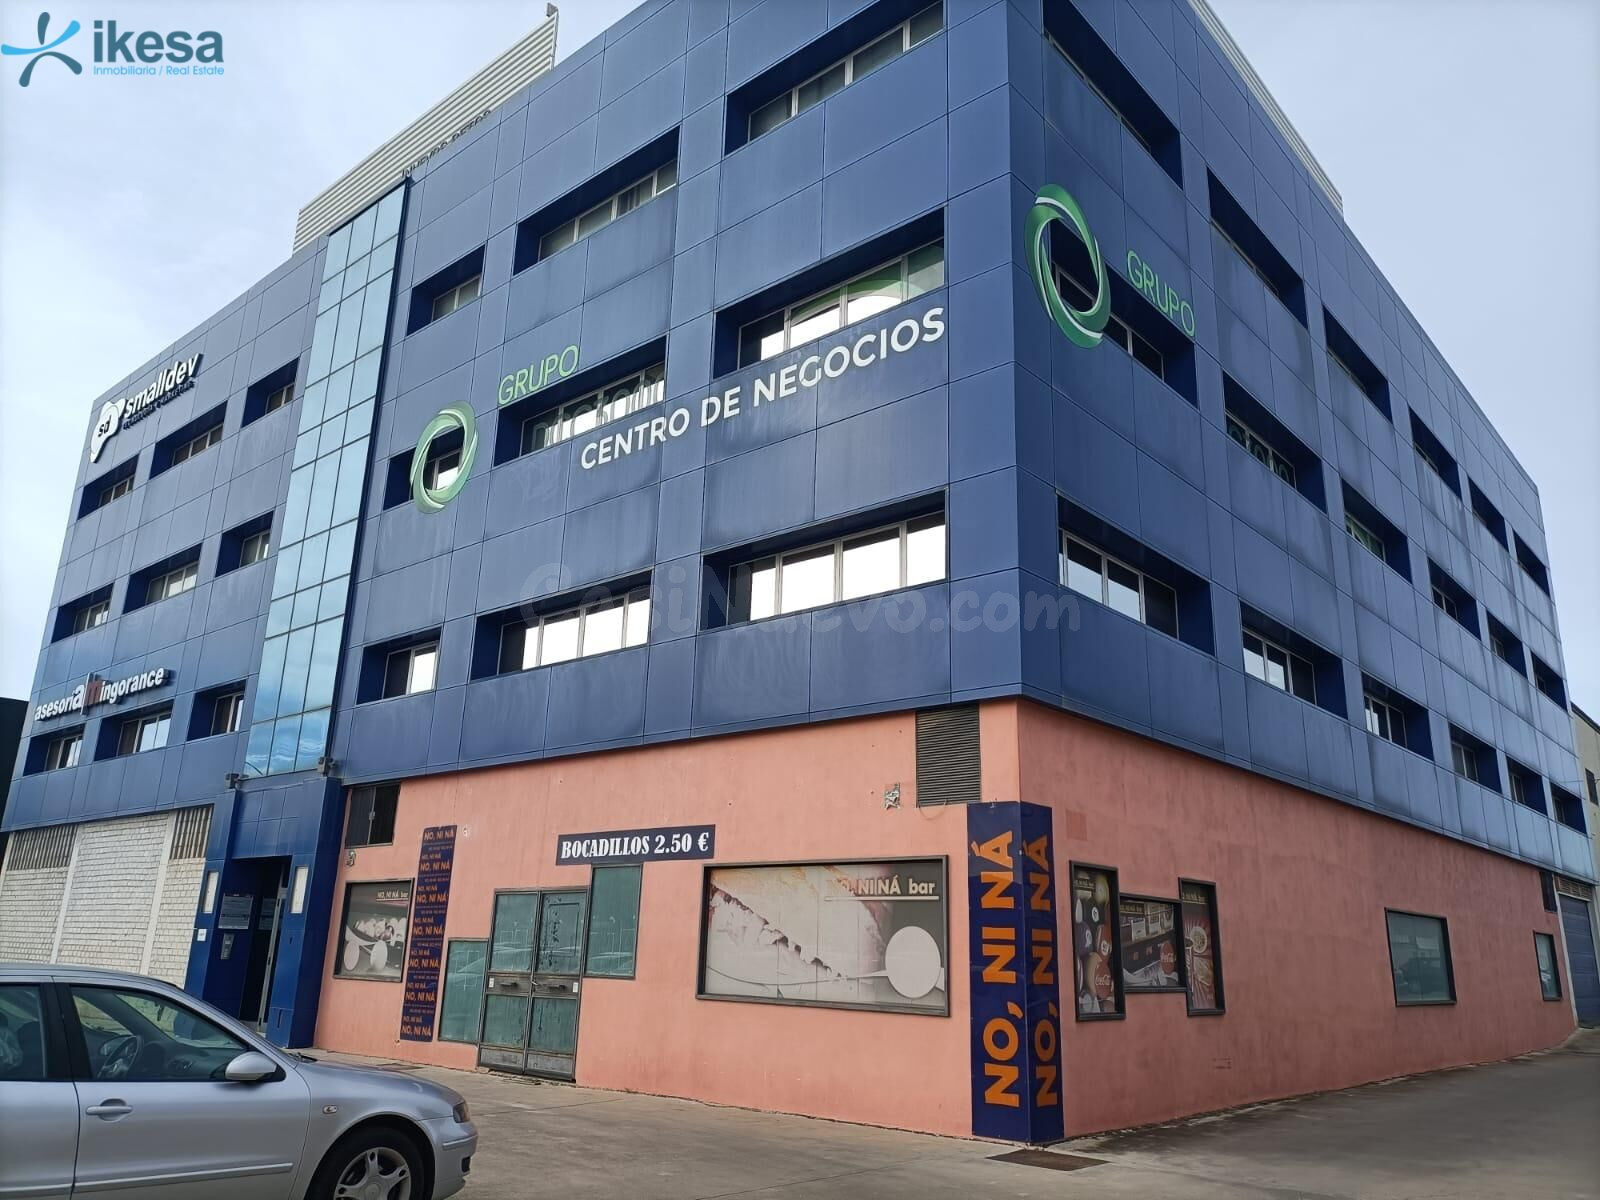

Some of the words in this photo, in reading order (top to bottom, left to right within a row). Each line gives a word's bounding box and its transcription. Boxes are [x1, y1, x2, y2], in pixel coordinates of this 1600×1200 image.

[1127, 250, 1195, 337] GRUPO
[124, 352, 200, 418] smalldev
[499, 345, 580, 406] GRUPO
[581, 408, 691, 470] CENTRO
[700, 387, 741, 428] DE
[753, 307, 946, 408] NEGOCIOS
[561, 835, 650, 859] BOCADILLOS
[654, 833, 692, 854] 2.50
[698, 831, 709, 851] €
[971, 831, 1015, 909] NÁ
[1023, 834, 1050, 911] NÁ
[908, 878, 936, 895] bar
[982, 927, 1017, 984] NI
[1032, 928, 1055, 985] NI
[983, 1001, 1024, 1108] NO,
[1034, 1002, 1058, 1107] NO,
